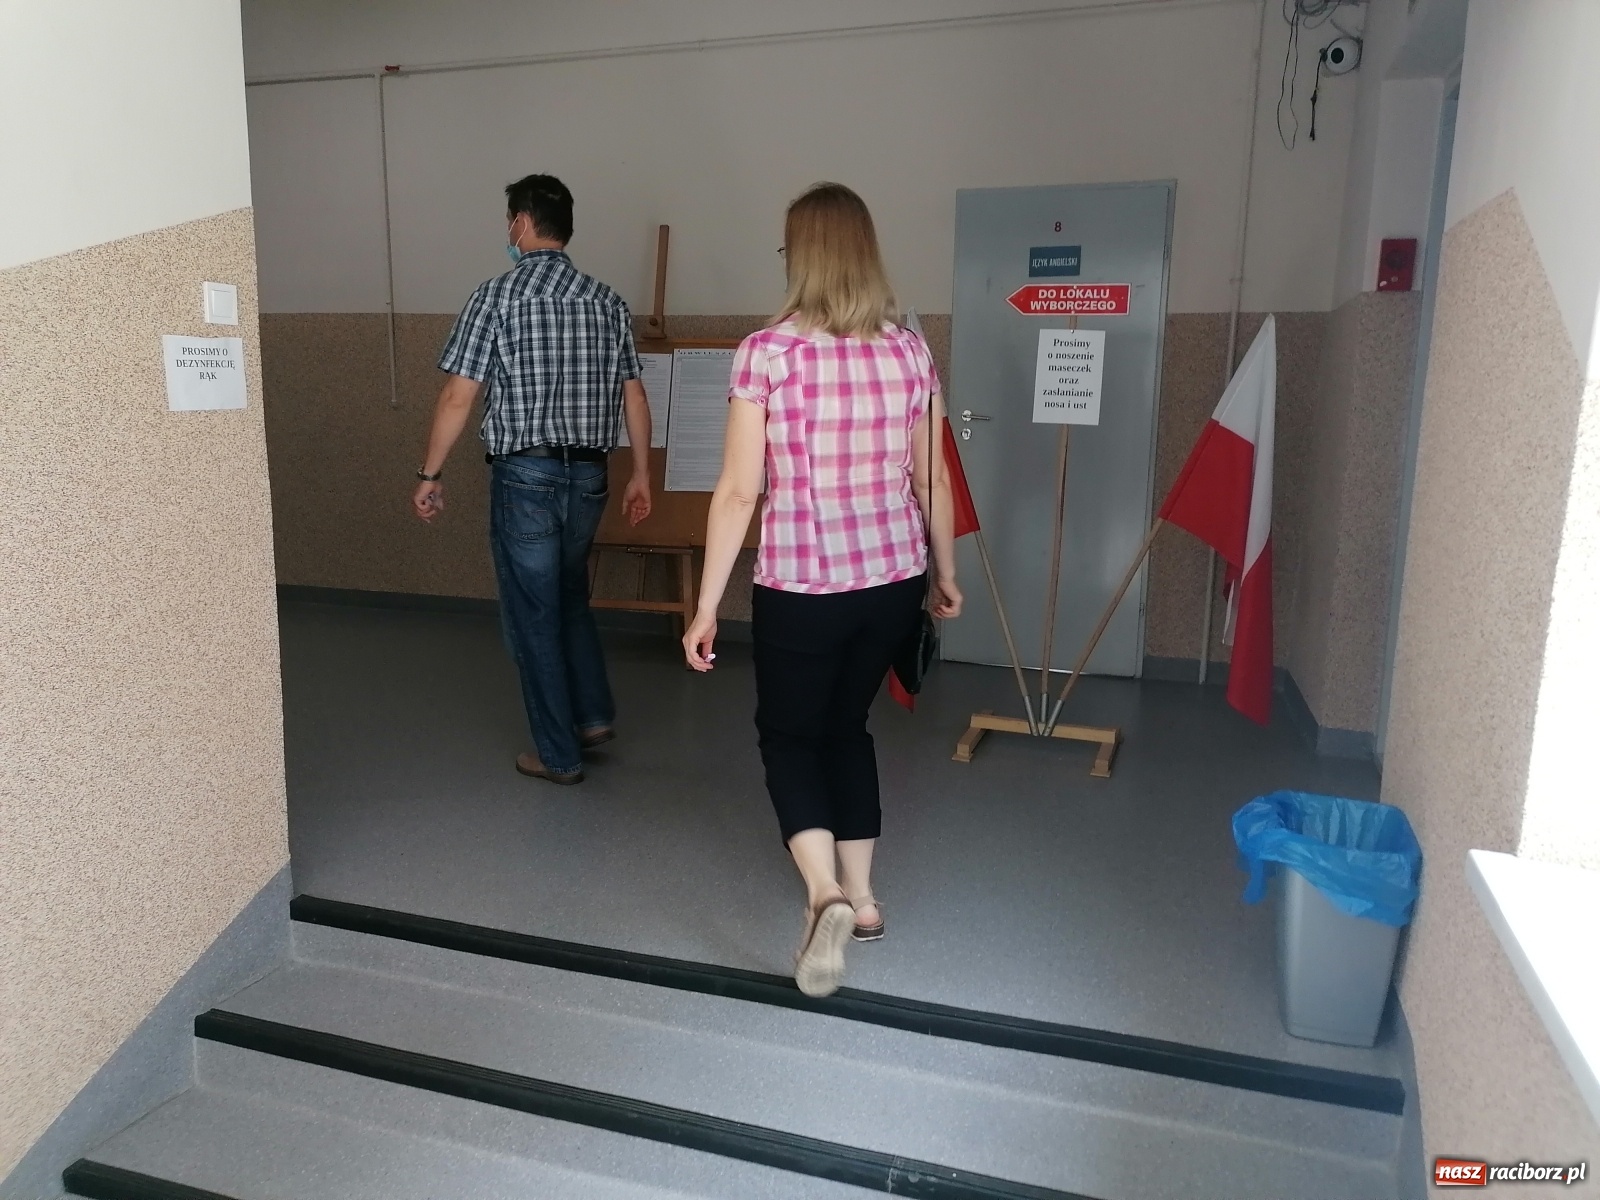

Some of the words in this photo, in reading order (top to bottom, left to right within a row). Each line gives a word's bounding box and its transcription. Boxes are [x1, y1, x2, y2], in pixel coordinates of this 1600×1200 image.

[1054, 221, 1062, 232] 8
[1032, 258, 1048, 268] JĘZYK
[1049, 257, 1078, 267] ANGIELSKI
[1038, 289, 1057, 299] DO
[1060, 288, 1110, 299] LOKALU
[1030, 300, 1117, 311] WYBORCZEGO
[1053, 338, 1091, 350] Prosimy
[182, 347, 220, 356] PROSIMY
[222, 348, 228, 356] O
[1055, 351, 1095, 360] noszenie
[176, 359, 235, 370] DEZYNFEKCJĘ
[1048, 363, 1092, 373] maseczek
[199, 372, 217, 381] RĄK
[1058, 377, 1079, 385] oraz
[1044, 401, 1065, 409] nosa
[1067, 400, 1071, 409] i
[1073, 402, 1087, 410] ust
